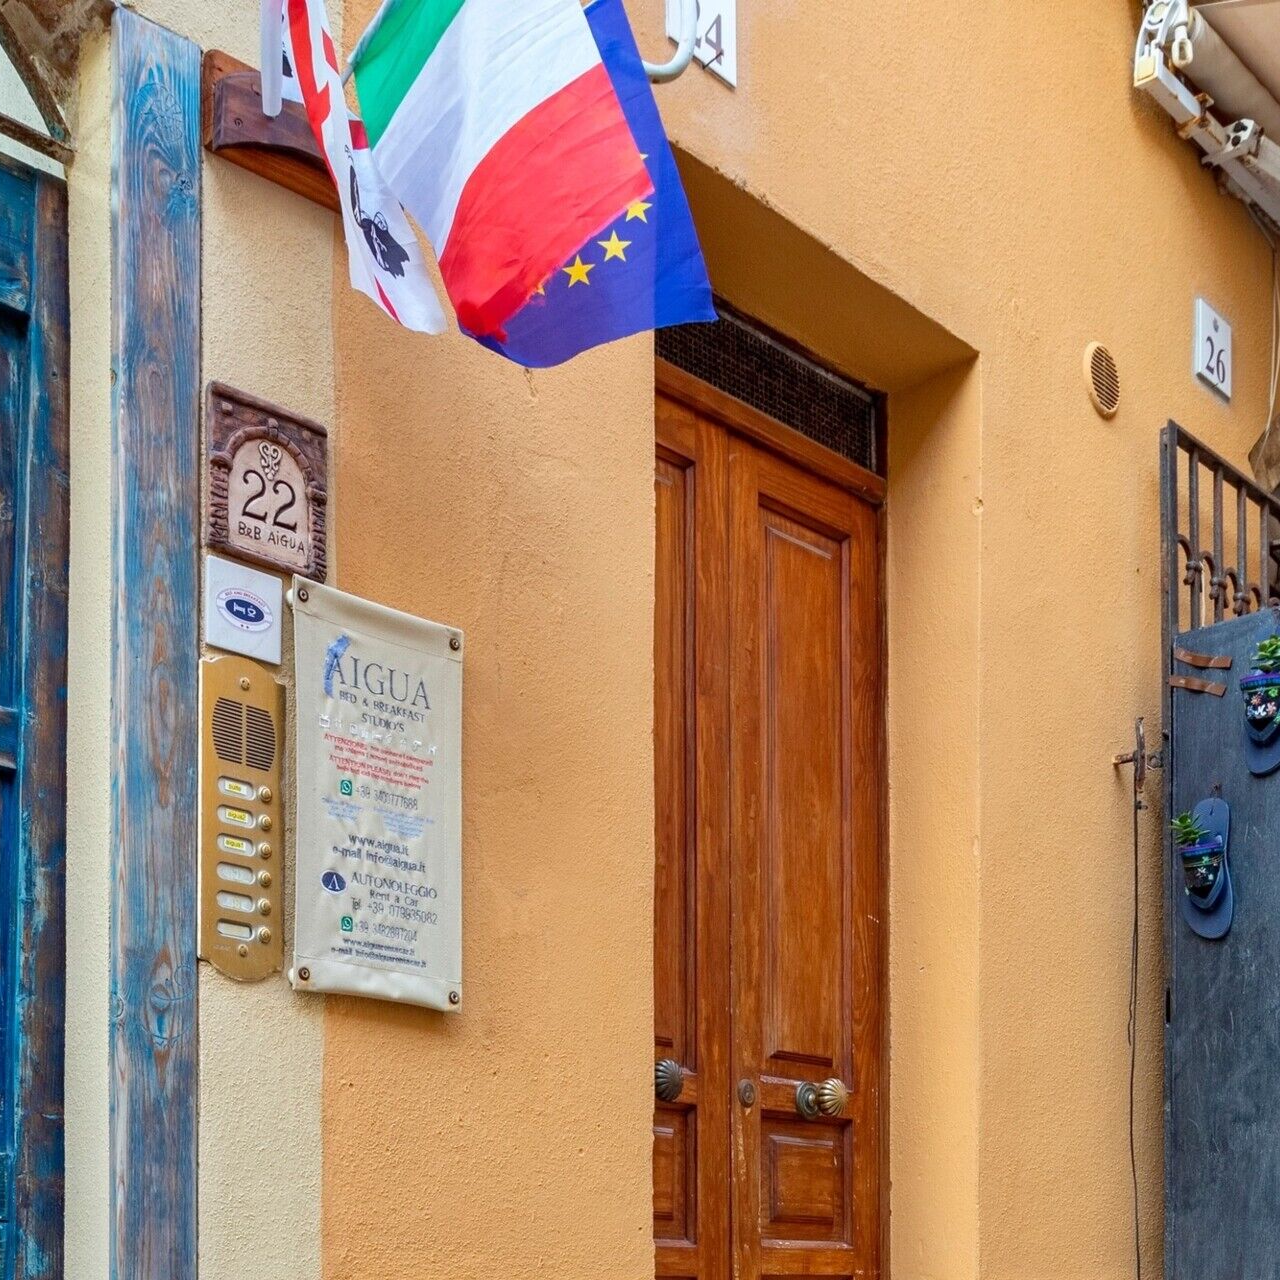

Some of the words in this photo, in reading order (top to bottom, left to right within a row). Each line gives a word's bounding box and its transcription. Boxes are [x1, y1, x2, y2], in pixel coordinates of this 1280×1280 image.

[1205, 335, 1226, 384] 26
[241, 469, 298, 534] 22
[325, 653, 432, 711] AIGUA
[339, 689, 357, 704] BED
[362, 697, 369, 708] &
[373, 700, 425, 723] BREAKFAST
[361, 712, 405, 732] STUDIO'S
[348, 833, 409, 857] www.aigua.it
[366, 849, 426, 873] info@aigua.it
[350, 871, 438, 900] AUTONOLEGGIO
[369, 889, 390, 901] Rent
[394, 895, 400, 904] a
[404, 896, 419, 908] Car
